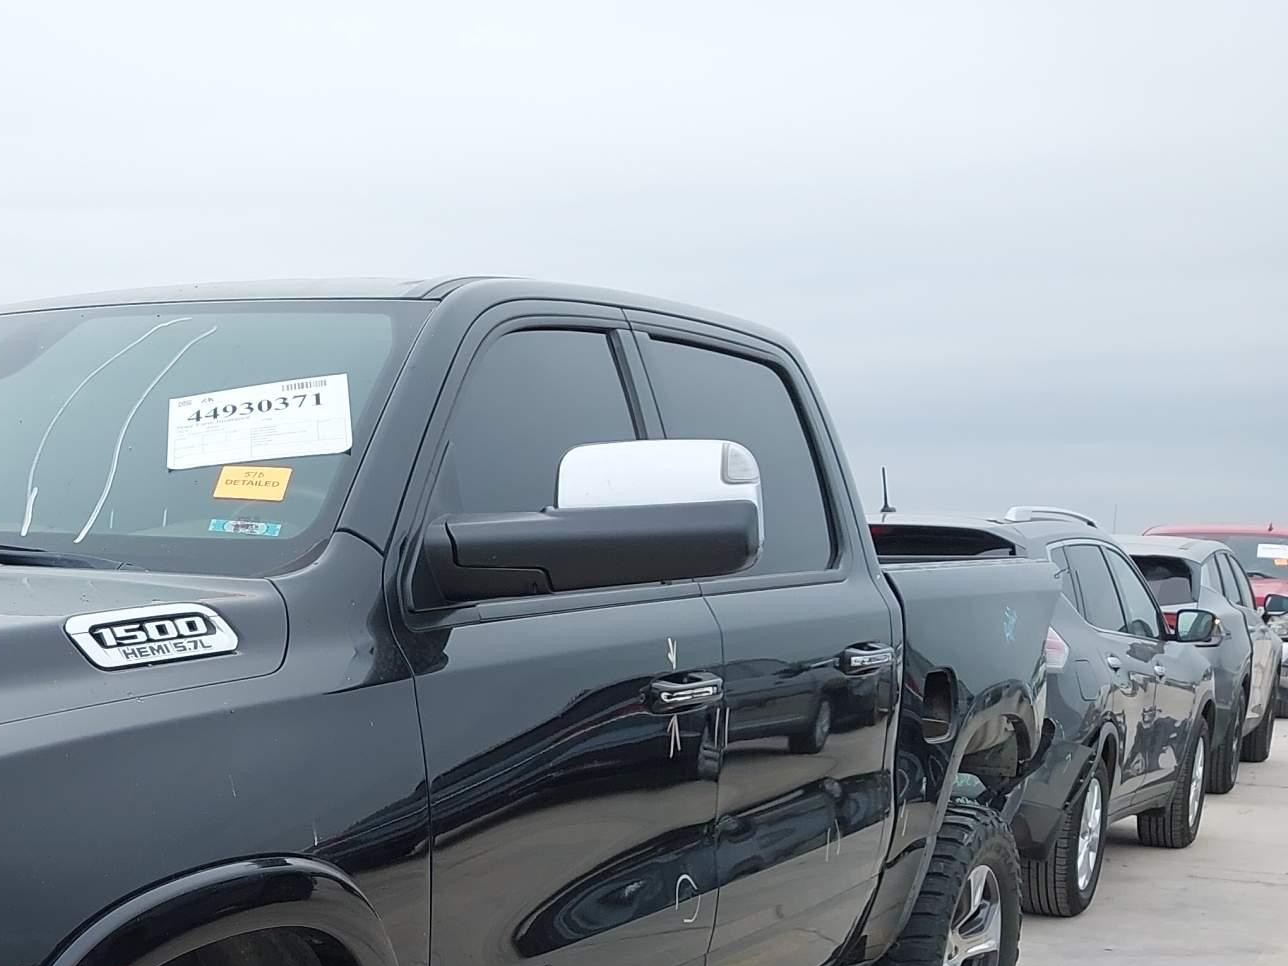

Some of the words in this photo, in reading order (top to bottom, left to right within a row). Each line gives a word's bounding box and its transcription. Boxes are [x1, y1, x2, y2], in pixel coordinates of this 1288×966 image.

[187, 392, 323, 422] 44930371
[225, 479, 280, 488] DETAILED
[93, 616, 208, 647] 1500
[122, 643, 169, 660] HEMI
[172, 639, 212, 653] 5.7L
